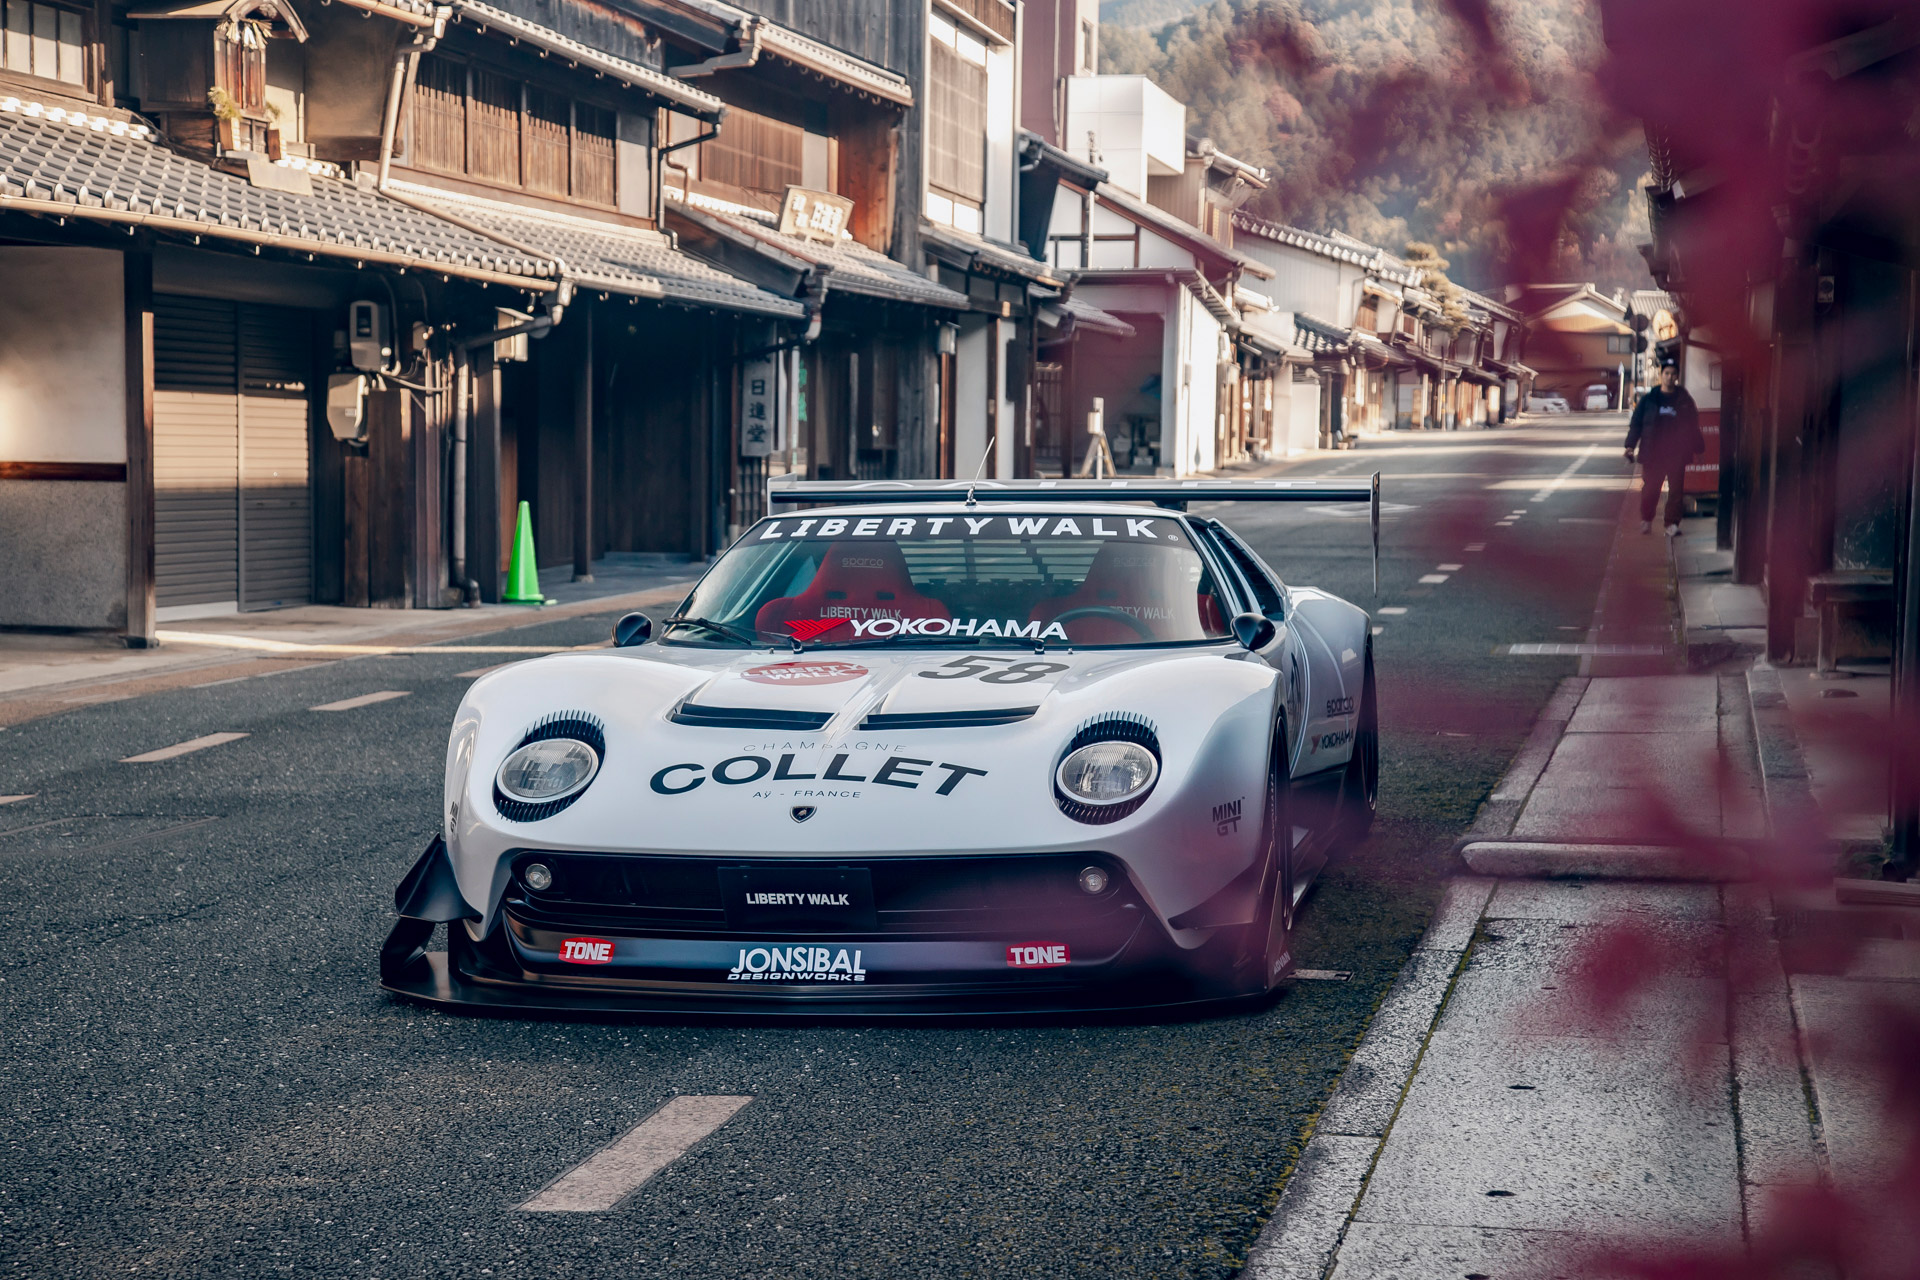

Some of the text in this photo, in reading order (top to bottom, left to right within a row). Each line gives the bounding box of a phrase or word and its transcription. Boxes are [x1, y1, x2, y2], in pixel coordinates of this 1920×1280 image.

[747, 379, 766, 443] 日進堂
[760, 517, 1158, 540] LIBERTY WALK
[841, 557, 884, 568] sparco
[820, 606, 903, 620] LIBERTY WALK
[1143, 606, 1176, 620] WALK
[850, 618, 1068, 641] YOKOHAMA
[742, 664, 868, 677] LIBERTY
[766, 669, 860, 680] WALK
[917, 655, 1070, 684] 58
[1326, 698, 1355, 717] sparco
[743, 741, 907, 752] CHAMPAGNE
[649, 753, 989, 796] COLLET
[794, 790, 862, 798] FRANCE
[1212, 799, 1241, 823] MINI
[1217, 815, 1241, 836] GT
[745, 892, 850, 905] LIBERTY WALK
[564, 941, 612, 961] TONE
[730, 947, 867, 974] JONSIBAL
[1010, 945, 1067, 965] TONE
[727, 972, 866, 981] DESIGNWORKS
